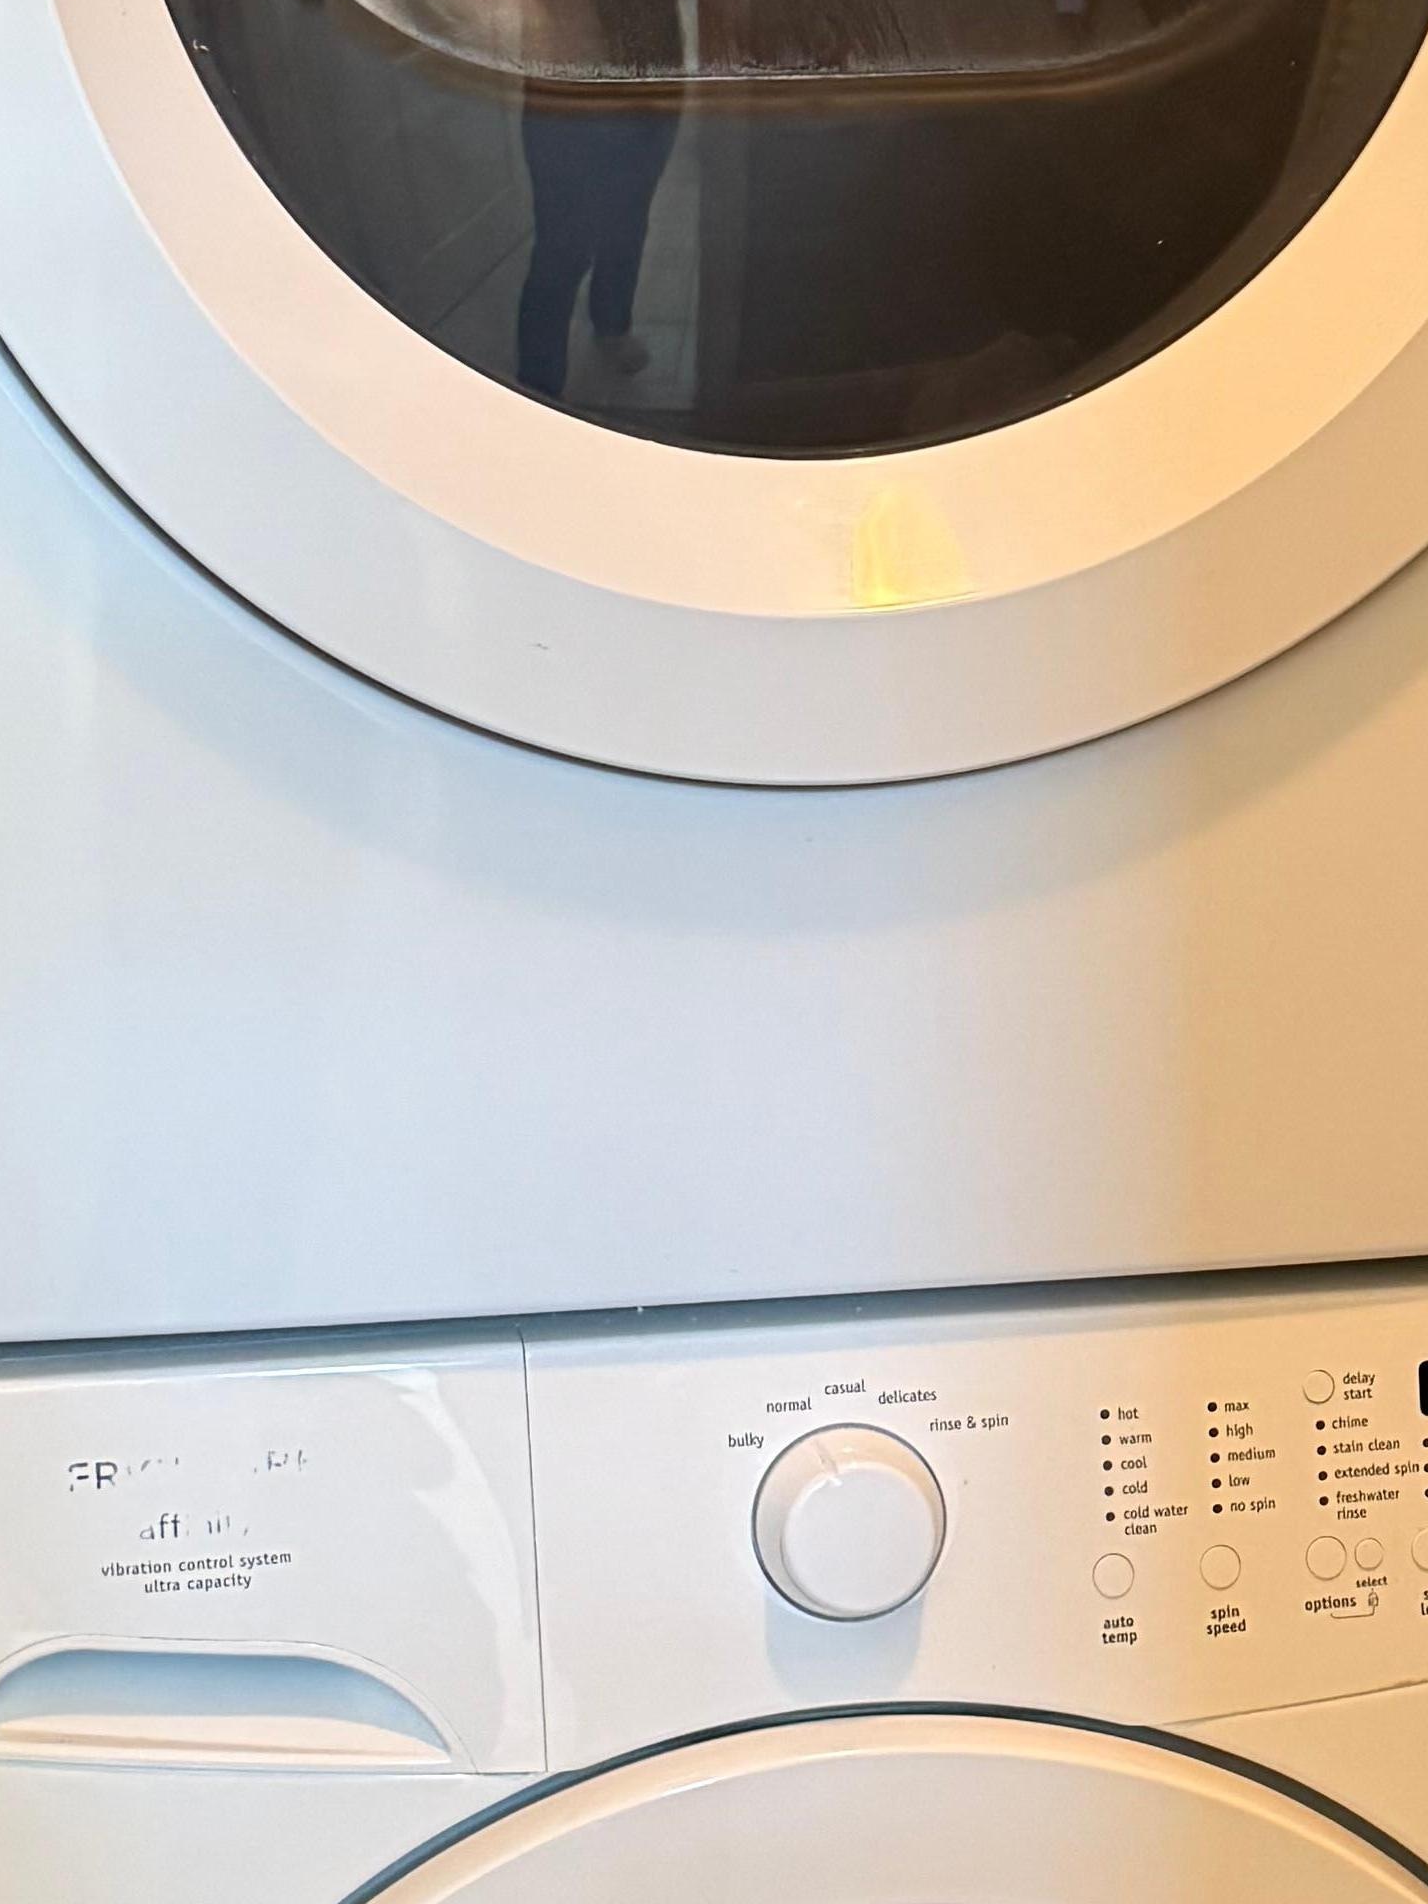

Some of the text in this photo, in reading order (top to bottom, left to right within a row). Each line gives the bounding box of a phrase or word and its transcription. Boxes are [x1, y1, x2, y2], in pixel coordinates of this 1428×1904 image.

[1343, 1371, 1375, 1386] delay
[824, 1379, 866, 1396] casual
[1343, 1386, 1373, 1401] start
[878, 1388, 937, 1405] delicates
[766, 1397, 812, 1414] normal
[1224, 1401, 1250, 1413] max
[1117, 1407, 1139, 1421] hot
[1331, 1414, 1369, 1430] chime
[929, 1413, 1009, 1432] rinse & spin
[1119, 1432, 1153, 1446] warm
[1225, 1424, 1254, 1440] high
[727, 1433, 764, 1449] bulky
[1332, 1437, 1400, 1454] stain clean
[1227, 1447, 1277, 1462] medium
[1120, 1456, 1148, 1471] cool
[1334, 1460, 1420, 1479] extended spin
[1122, 1480, 1148, 1495] cold
[1229, 1474, 1251, 1487] low
[1336, 1487, 1401, 1504] freshwater
[1123, 1503, 1189, 1520] cold water
[1229, 1497, 1277, 1514] no spin
[1336, 1505, 1367, 1521] rinse
[1124, 1521, 1157, 1536] clean
[100, 1551, 293, 1578] vibration control system
[144, 1573, 253, 1594] ultra capacity
[1355, 1575, 1388, 1589] select
[1210, 1604, 1241, 1622] spin
[1304, 1596, 1357, 1614] options
[1103, 1615, 1135, 1630] auto
[1206, 1619, 1247, 1638] speed
[1102, 1629, 1138, 1647] temp
